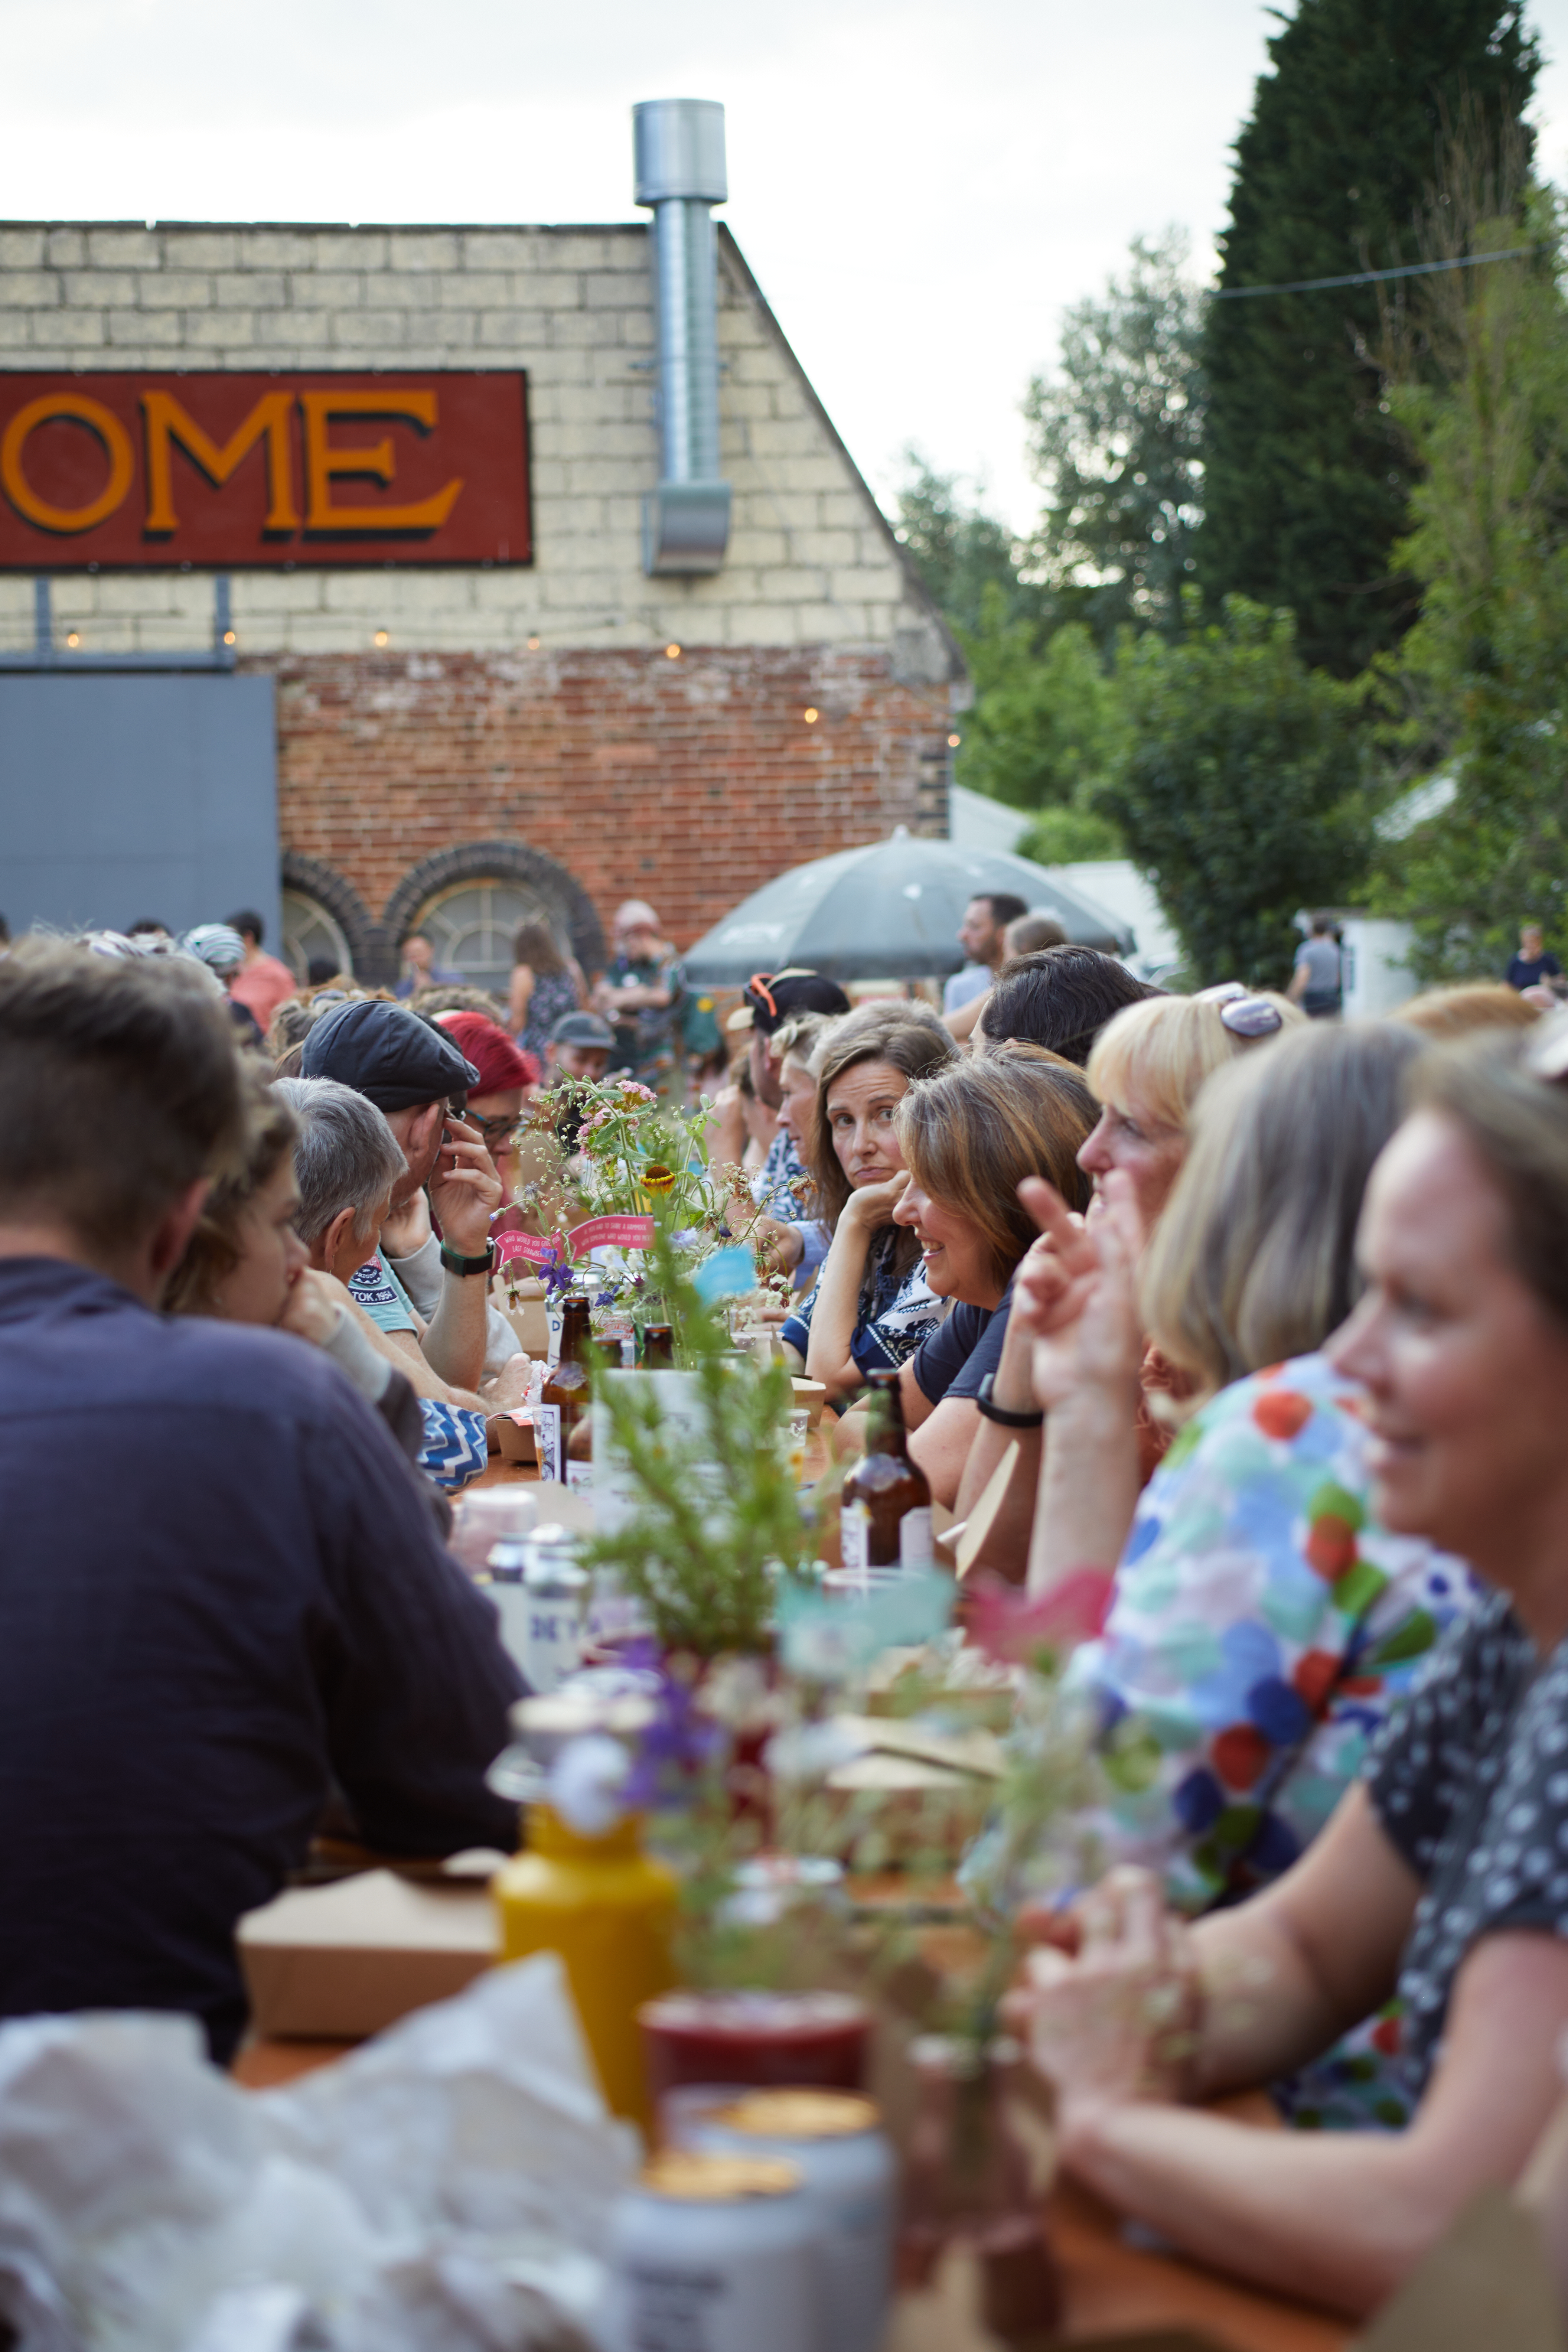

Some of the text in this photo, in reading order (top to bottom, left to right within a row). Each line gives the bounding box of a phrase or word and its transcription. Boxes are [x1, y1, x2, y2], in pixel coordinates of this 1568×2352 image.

[0, 390, 464, 542] OME
[504, 1235, 515, 1243] WHO
[516, 1235, 531, 1245] WOULD
[551, 1235, 561, 1245] YOUR
[581, 1238, 589, 1247] WITH
[590, 1233, 606, 1242] SOMEONE
